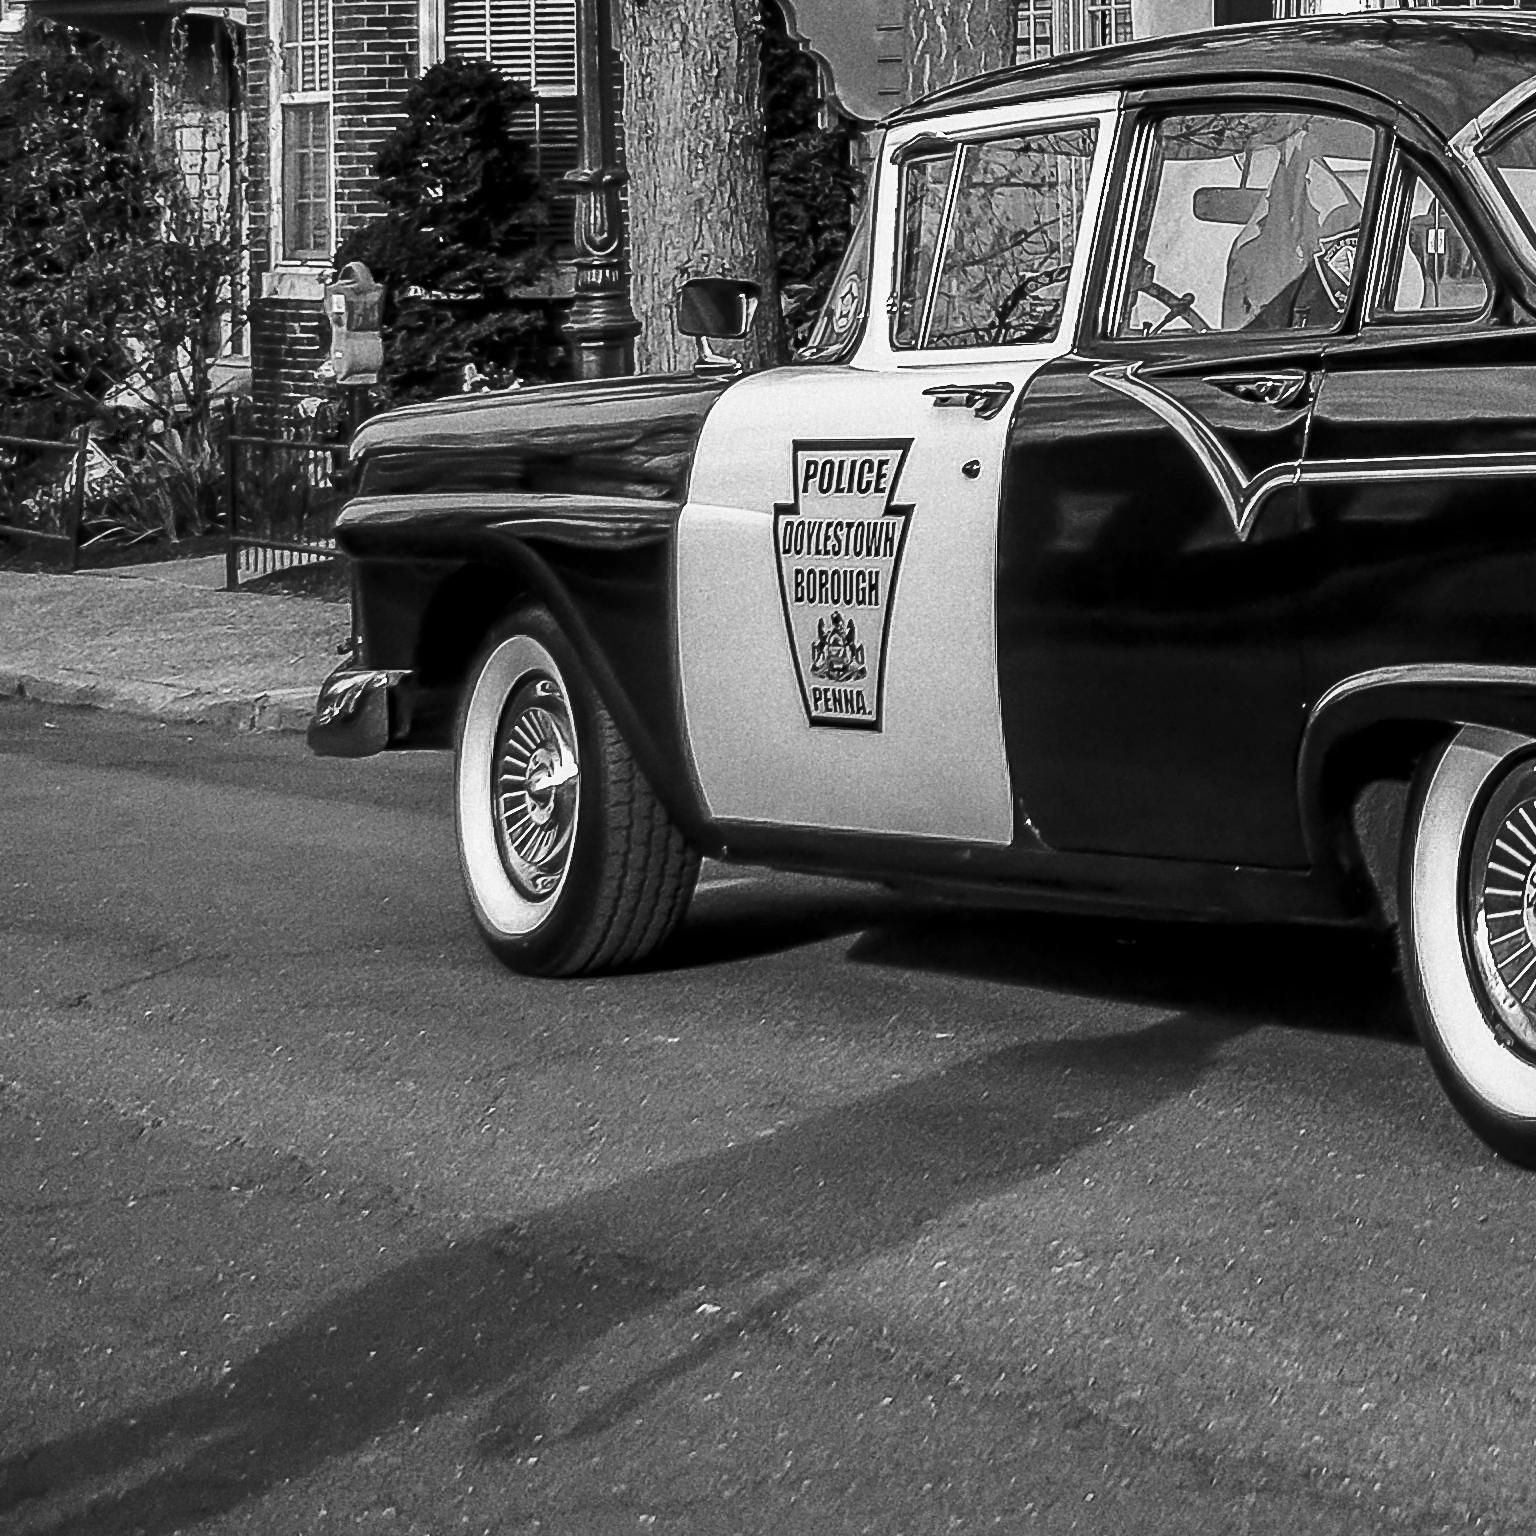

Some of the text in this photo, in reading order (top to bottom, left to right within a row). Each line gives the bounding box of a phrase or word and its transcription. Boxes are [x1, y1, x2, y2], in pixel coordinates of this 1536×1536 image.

[801, 458, 890, 495] POLICE
[781, 520, 897, 558] DOYLESTOWN
[793, 567, 880, 607] BOROUGH
[811, 687, 872, 716] PENNA.
